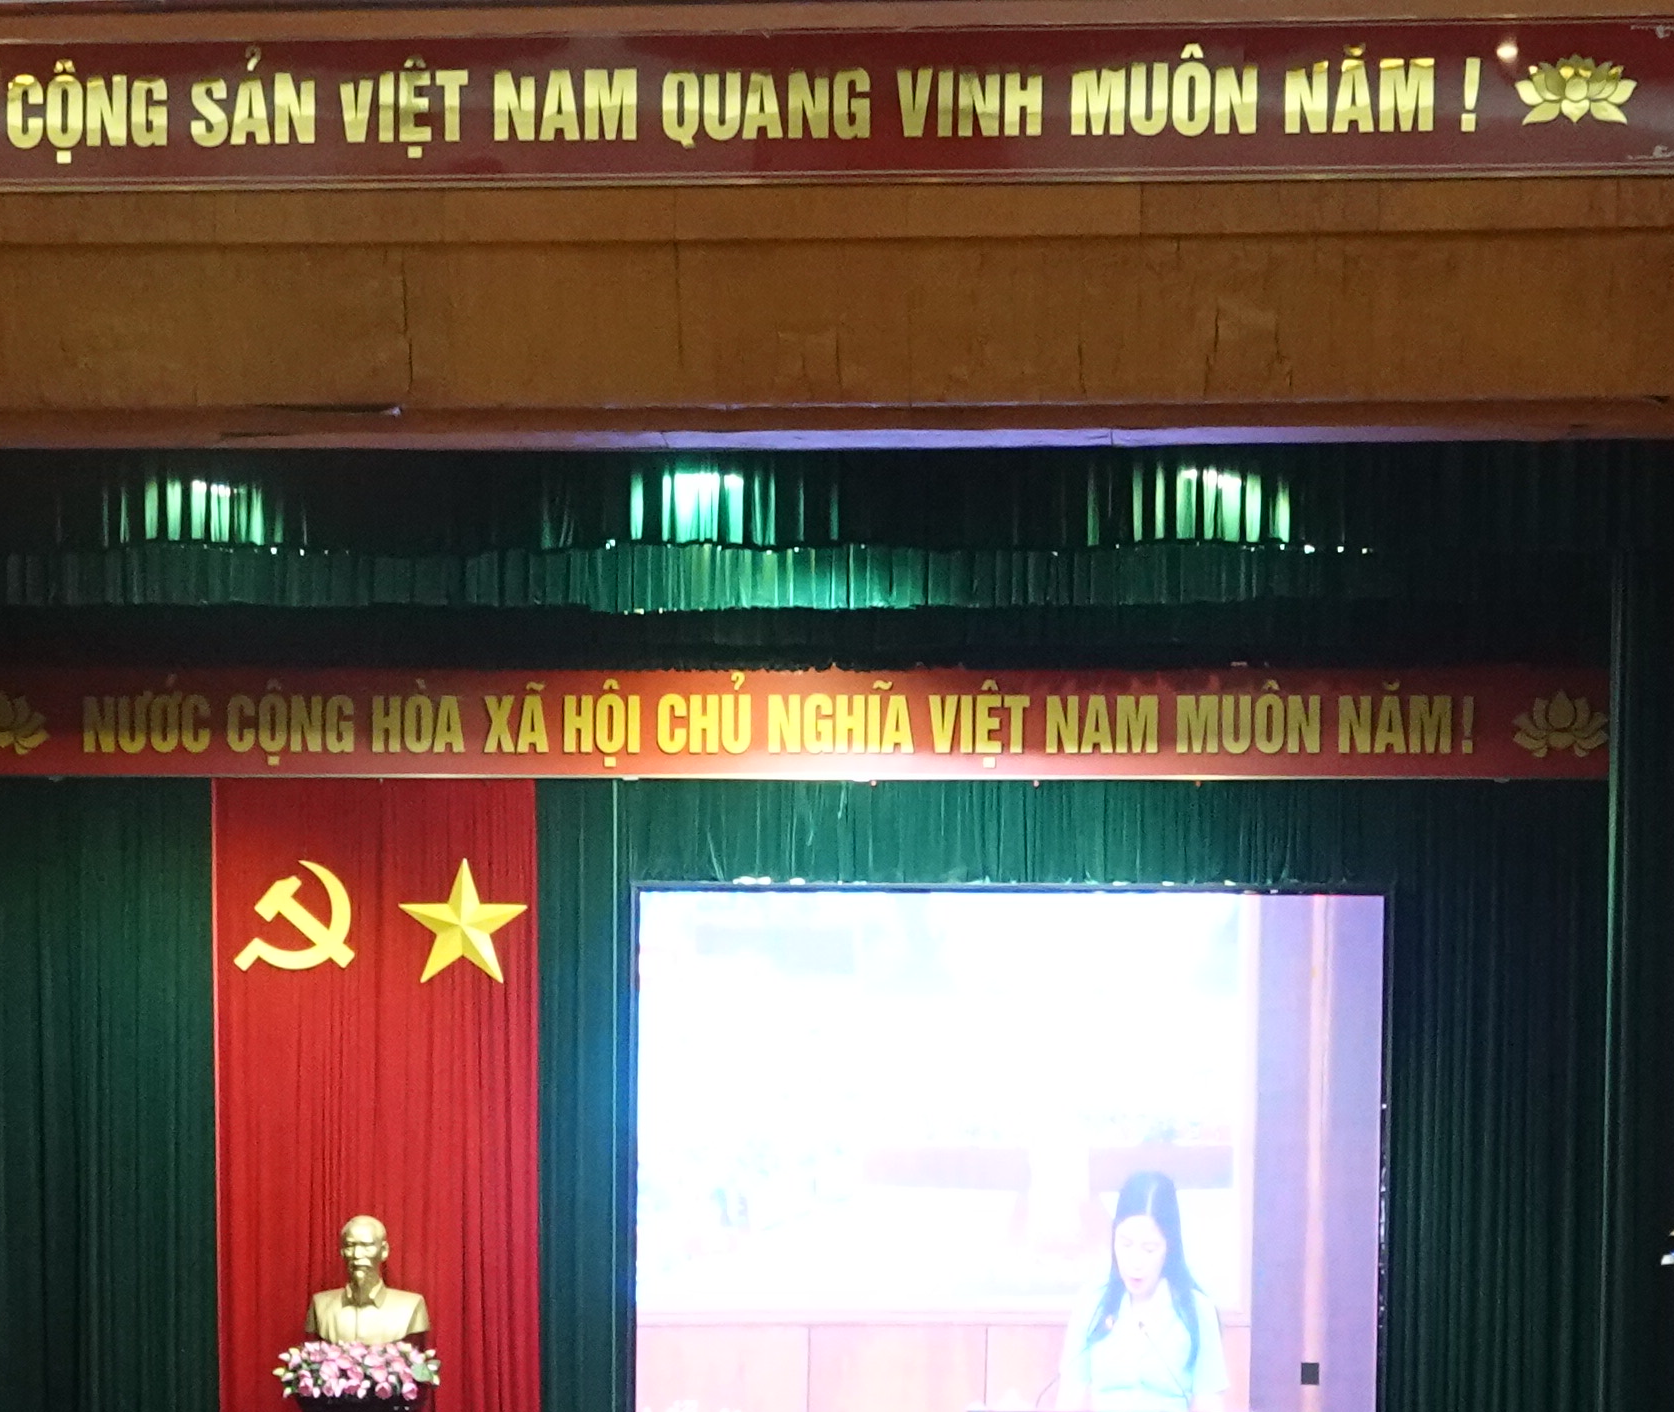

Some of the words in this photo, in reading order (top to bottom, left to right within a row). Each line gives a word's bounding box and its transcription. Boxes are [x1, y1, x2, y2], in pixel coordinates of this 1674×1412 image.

[6, 59, 168, 163] CỘNG
[190, 45, 316, 147] SẢN
[338, 55, 467, 159] VIỆT
[493, 68, 637, 141] NAM
[661, 66, 872, 148] QUANG
[896, 68, 1042, 139] VINH
[1069, 42, 1257, 137] MUÔN
[82, 673, 211, 755] NƯỚC
[225, 677, 355, 766] CỘNG
[372, 677, 465, 753] HÒA
[483, 681, 549, 753] XÃ
[563, 678, 640, 766] HỘI
[657, 672, 753, 753] CHỦ
[768, 680, 914, 754] NGHĨA
[928, 680, 1031, 768] VIỆT
[1045, 694, 1159, 754] NAM
[1176, 680, 1321, 754] MUÔN
